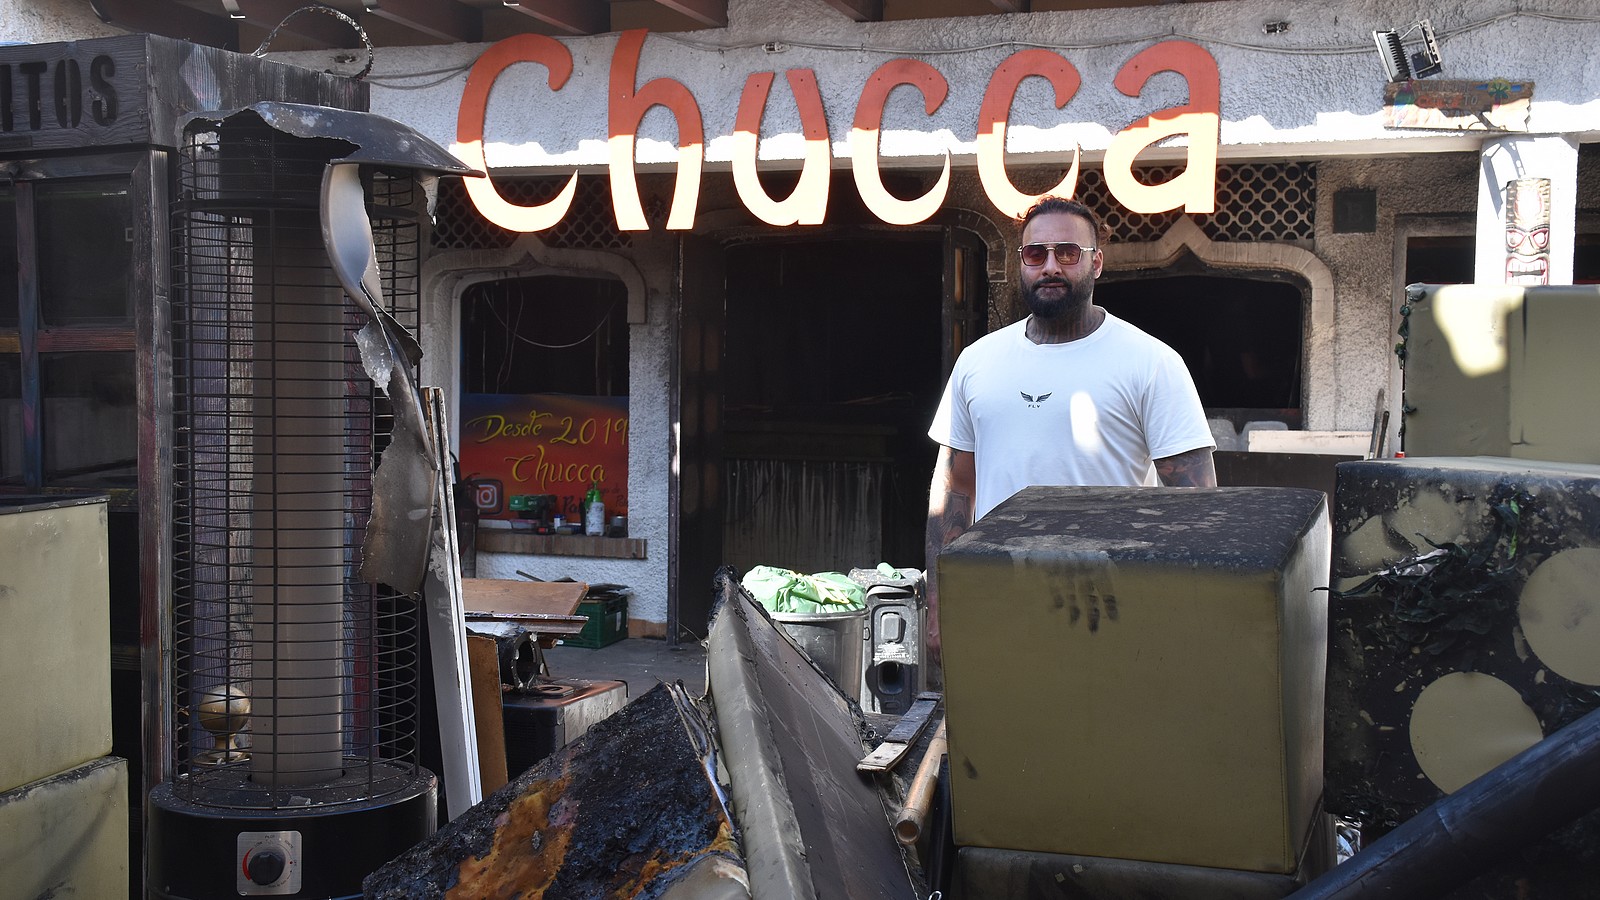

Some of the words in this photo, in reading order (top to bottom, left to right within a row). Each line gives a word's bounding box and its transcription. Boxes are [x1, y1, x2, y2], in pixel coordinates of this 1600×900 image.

[456, 28, 1220, 232] Chucca
[465, 410, 552, 443] Desde
[550, 415, 628, 445] 2019
[504, 444, 606, 491] Chucca
